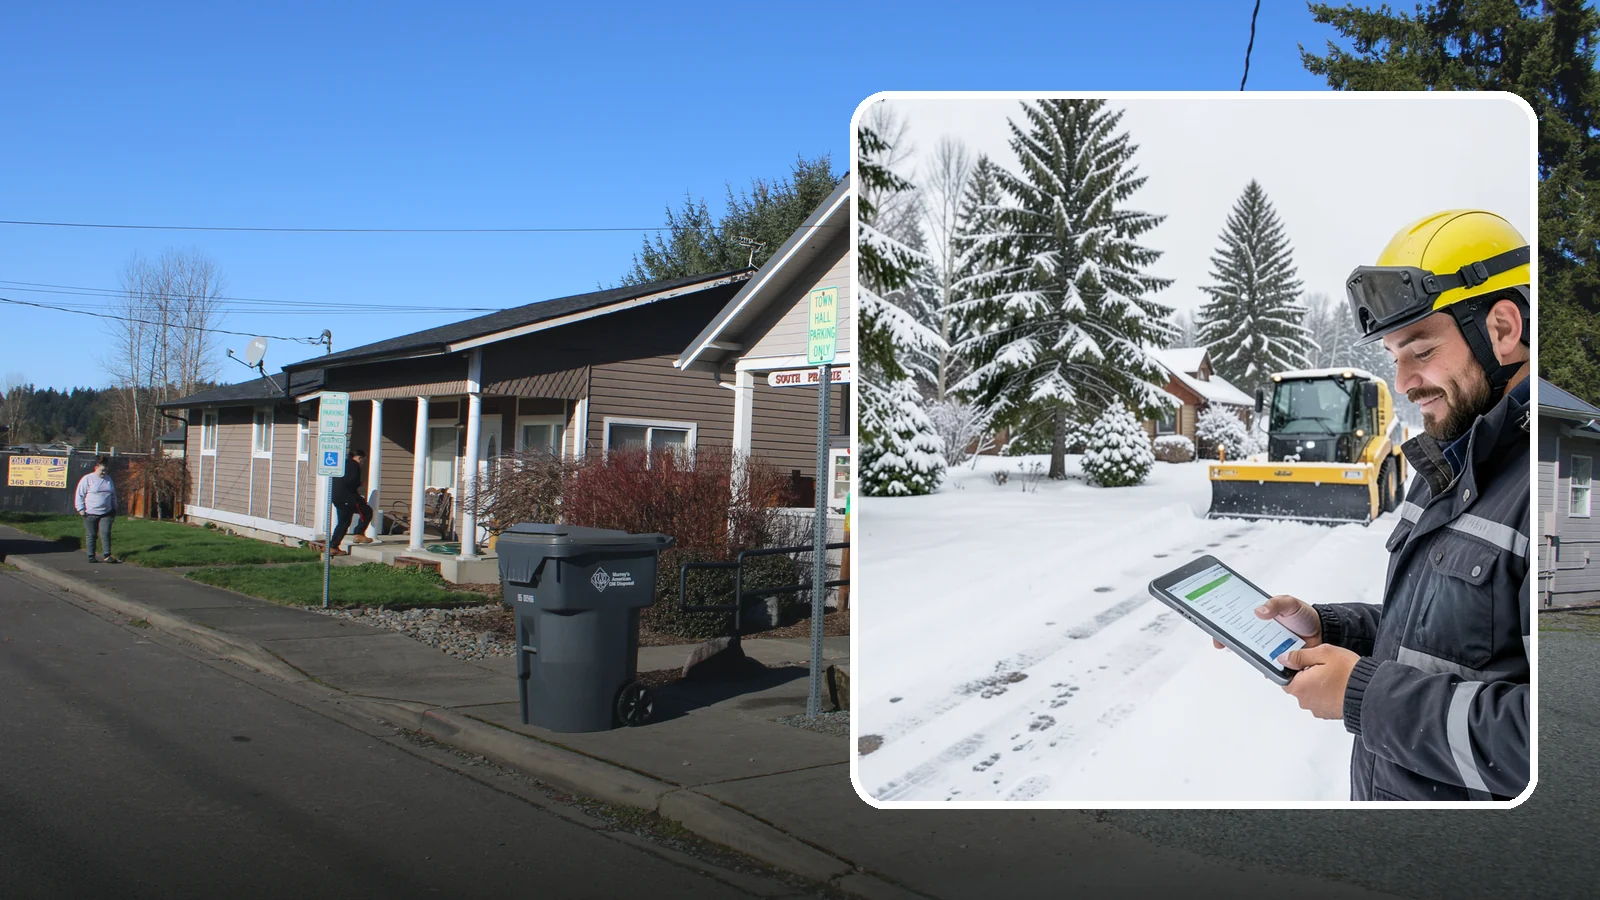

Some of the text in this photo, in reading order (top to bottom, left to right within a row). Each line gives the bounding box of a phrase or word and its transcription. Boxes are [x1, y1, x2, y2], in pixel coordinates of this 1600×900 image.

[815, 295, 832, 308] TOWN
[815, 312, 831, 324] HALL
[810, 326, 836, 340] PARKING
[814, 344, 830, 356] ONLY
[776, 374, 801, 384] SOUTH
